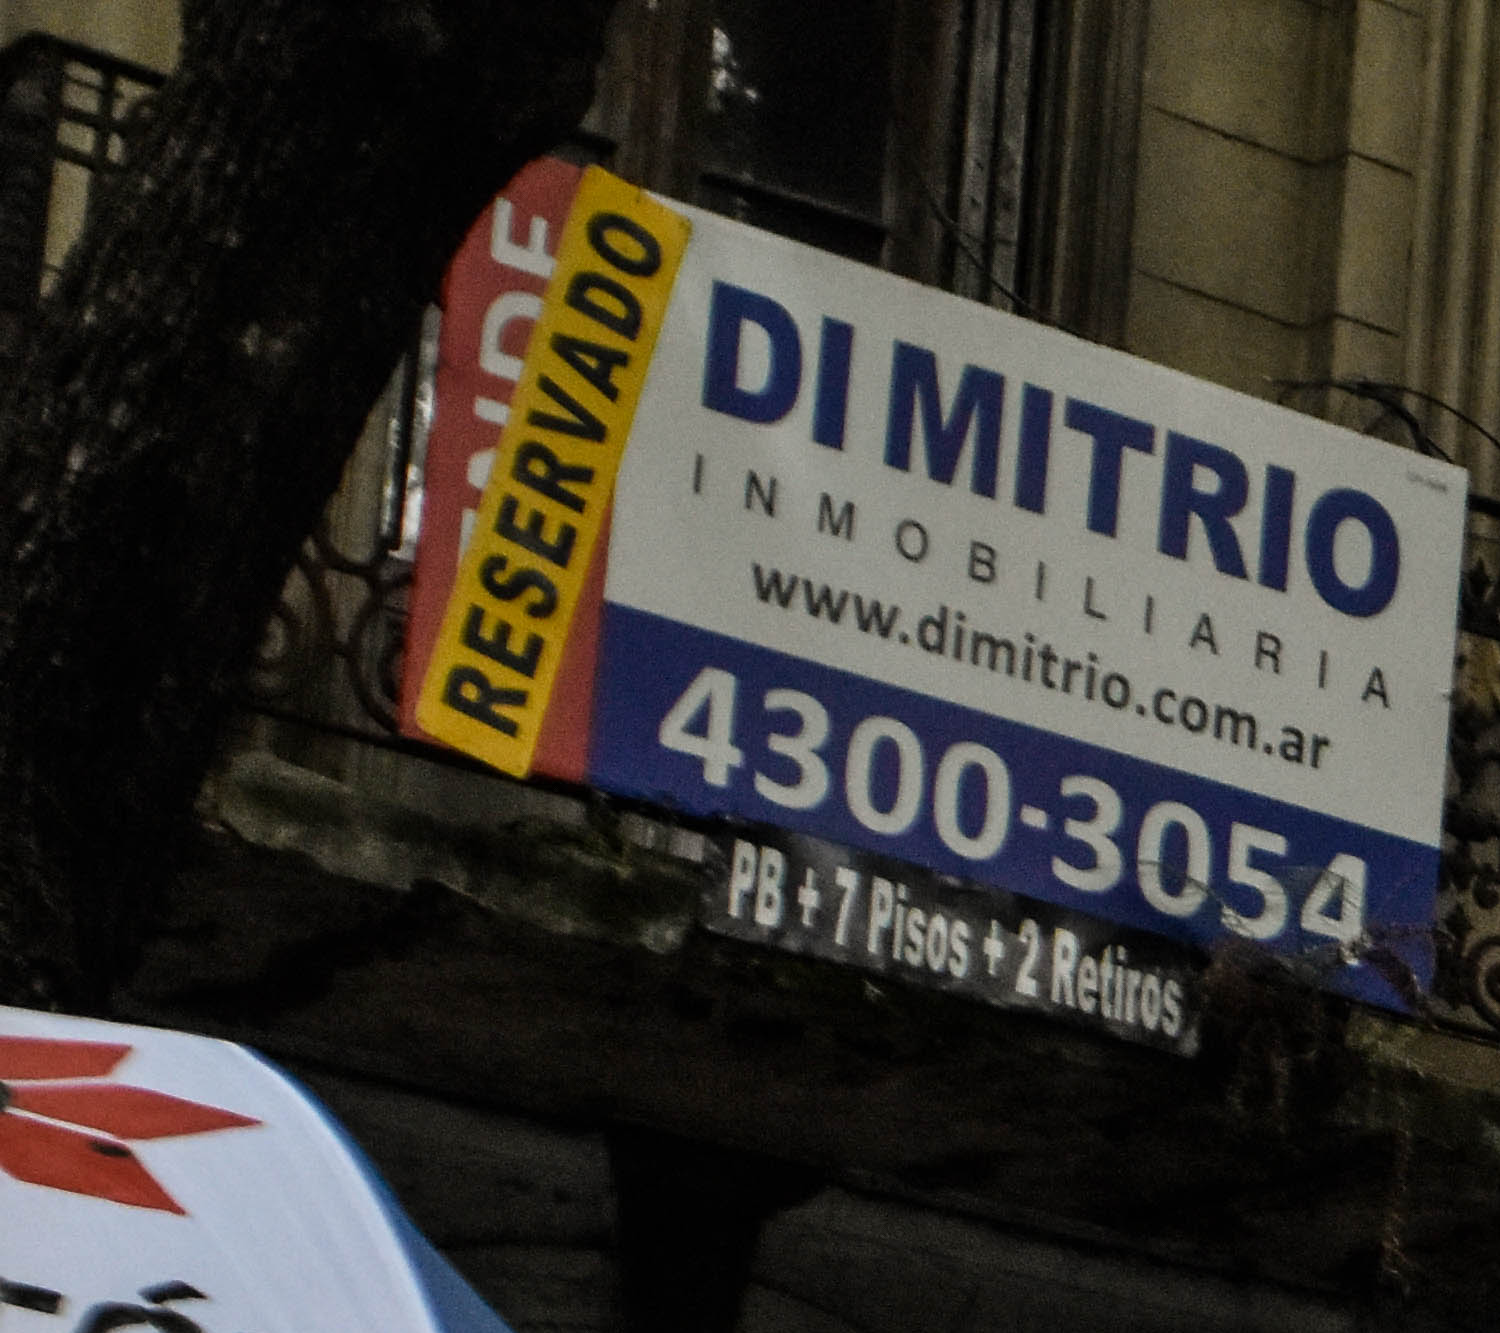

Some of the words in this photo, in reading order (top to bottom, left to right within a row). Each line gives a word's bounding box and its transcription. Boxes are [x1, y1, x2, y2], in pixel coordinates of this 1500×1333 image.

[440, 210, 664, 738] RESERVADO
[692, 452, 1392, 710] INMOBILIARIA
[751, 562, 1331, 770] www.dimitrio.com.ar
[657, 665, 1368, 967] 4300-3054
[727, 837, 786, 928] PB
[834, 865, 863, 946] 7
[866, 875, 971, 979] Pisos
[1015, 918, 1042, 997] 2
[1050, 926, 1184, 1038] Retiros
